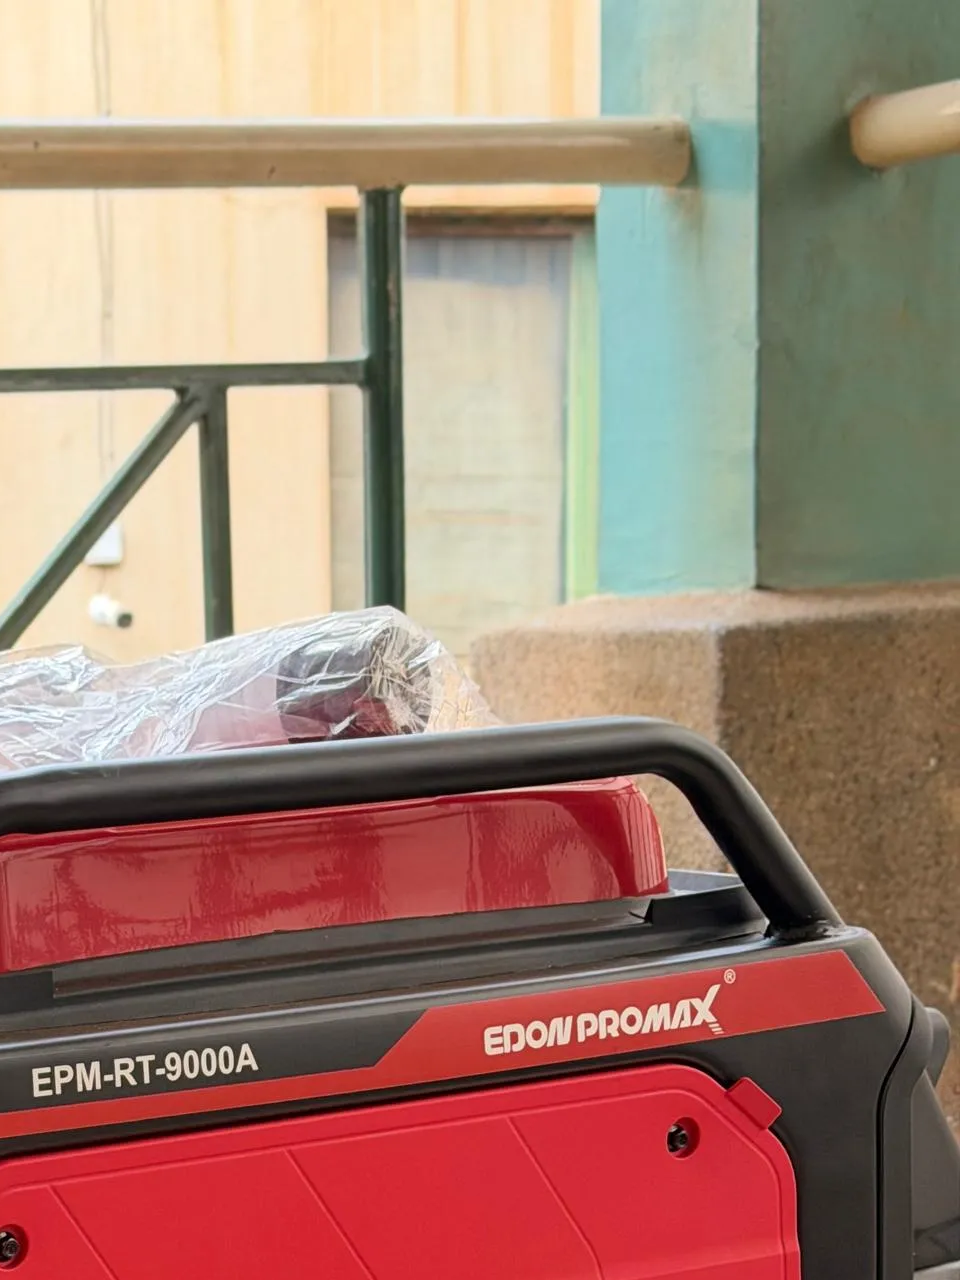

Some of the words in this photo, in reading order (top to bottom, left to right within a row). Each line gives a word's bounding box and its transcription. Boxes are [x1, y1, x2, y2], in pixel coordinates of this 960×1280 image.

[484, 1016, 573, 1056] EDON
[577, 984, 725, 1043] PROMAX
[31, 1043, 258, 1097] EPM-RT-9000A
